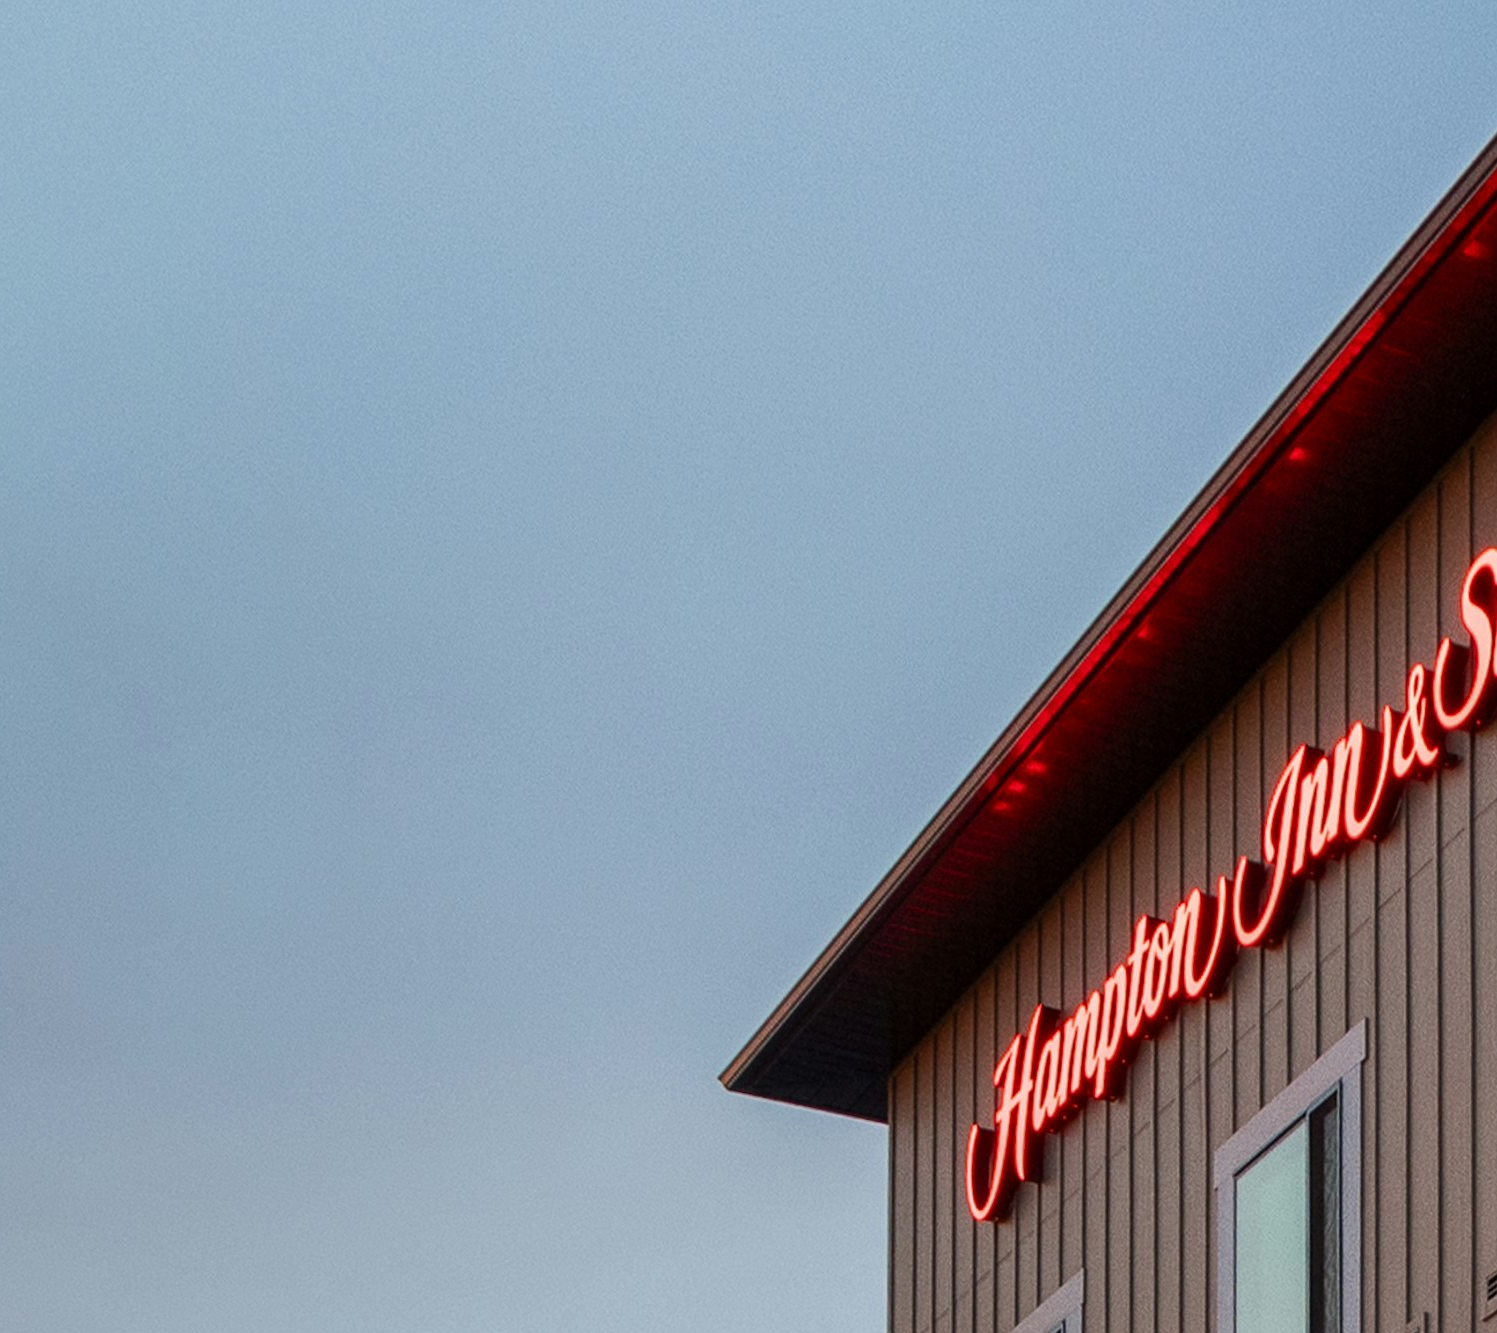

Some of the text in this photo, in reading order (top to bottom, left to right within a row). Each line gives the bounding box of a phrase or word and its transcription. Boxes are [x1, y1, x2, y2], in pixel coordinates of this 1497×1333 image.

[966, 875, 1228, 1221] Hampton
[1233, 704, 1392, 945] Inn
[1392, 662, 1439, 777] &
